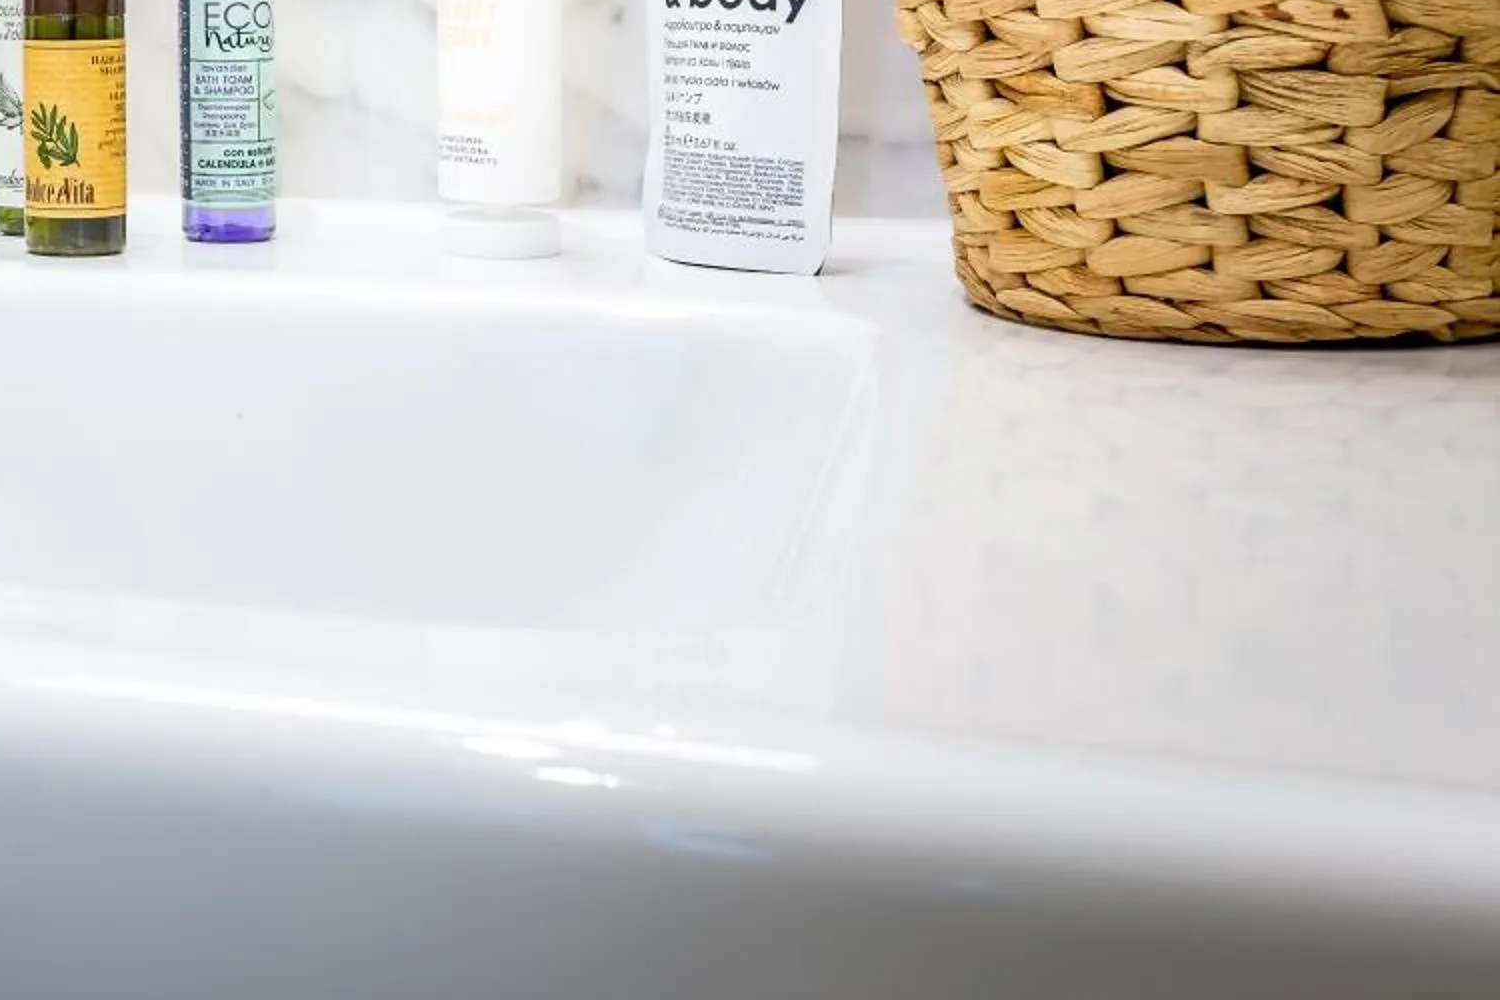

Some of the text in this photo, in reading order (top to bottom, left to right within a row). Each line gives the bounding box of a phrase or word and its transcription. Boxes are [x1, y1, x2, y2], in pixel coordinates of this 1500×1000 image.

[204, 1, 273, 30] ECO
[195, 75, 253, 85] BATH FOAM
[203, 85, 255, 96] SHAMPOO
[198, 158, 257, 169] CALENDULA
